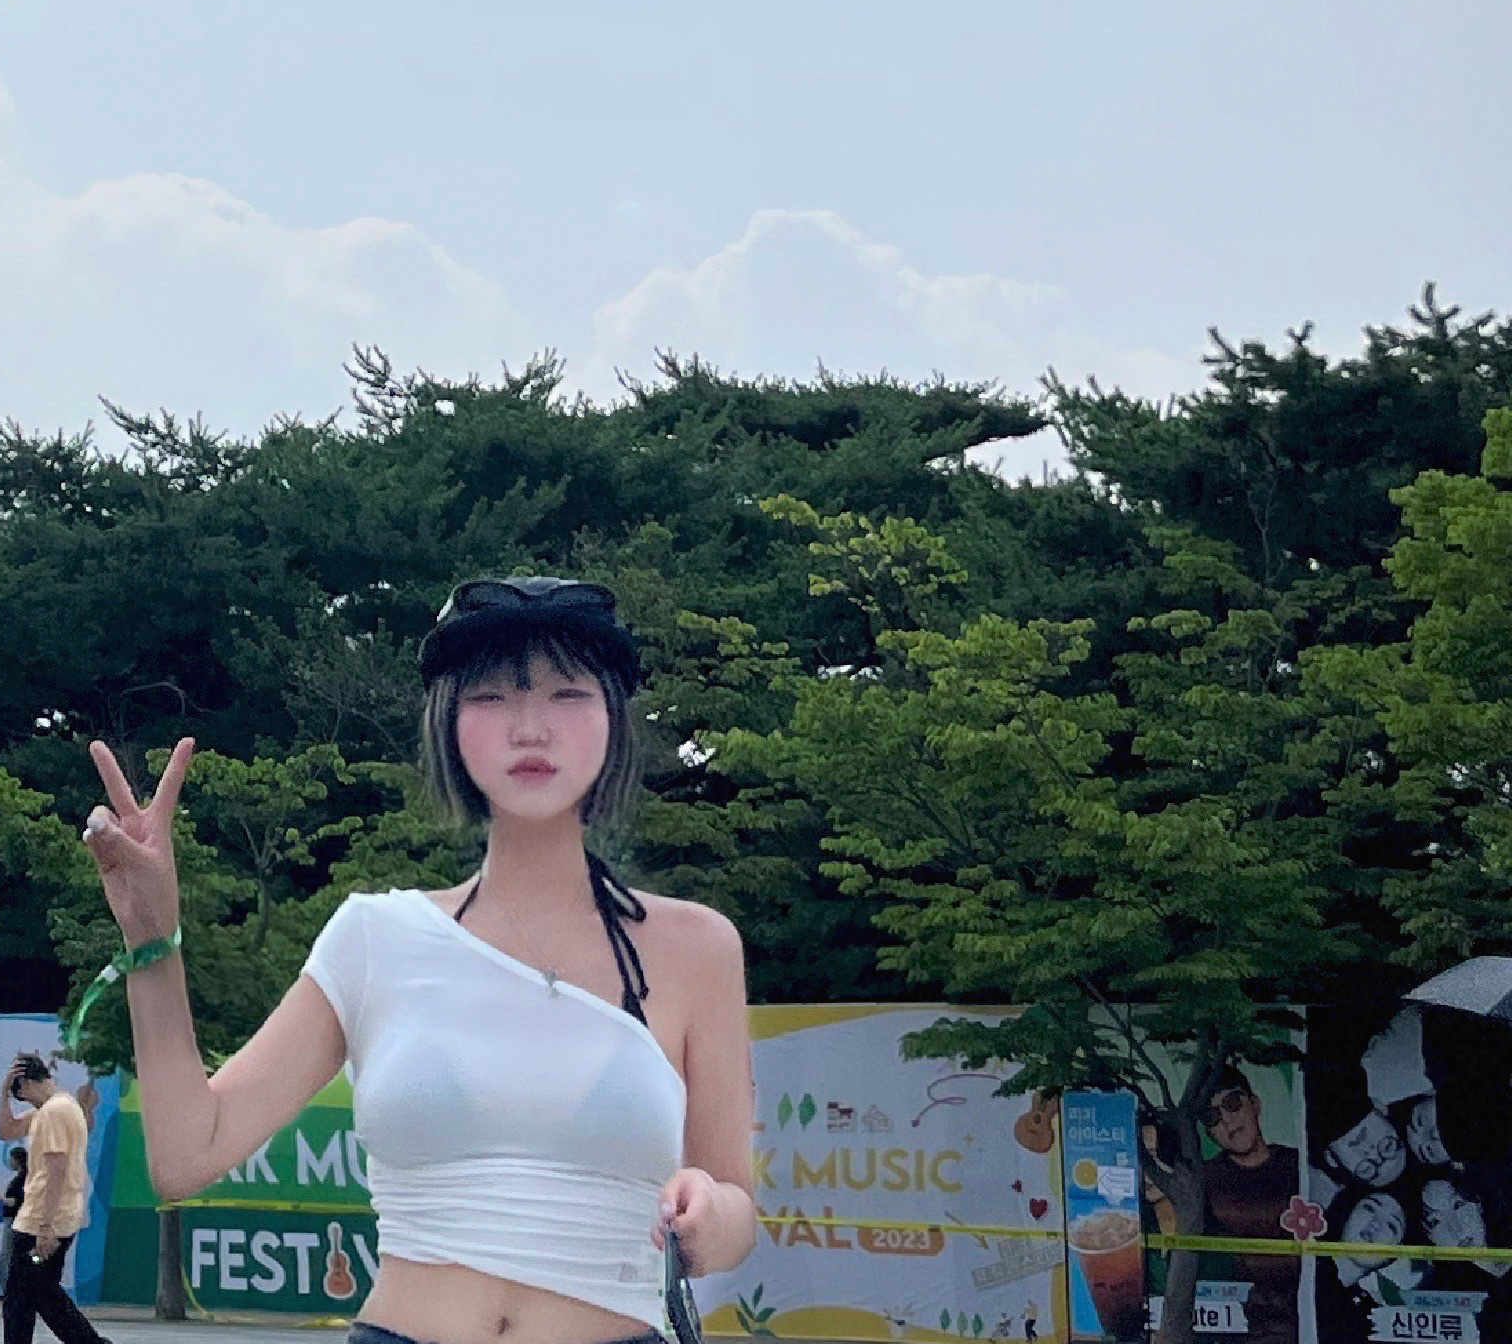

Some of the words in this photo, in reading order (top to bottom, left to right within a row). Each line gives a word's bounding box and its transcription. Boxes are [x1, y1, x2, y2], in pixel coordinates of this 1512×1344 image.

[792, 1147, 964, 1193] MUSIC
[871, 1226, 932, 1251] 2023
[1392, 1311, 1463, 1341] 신인류
